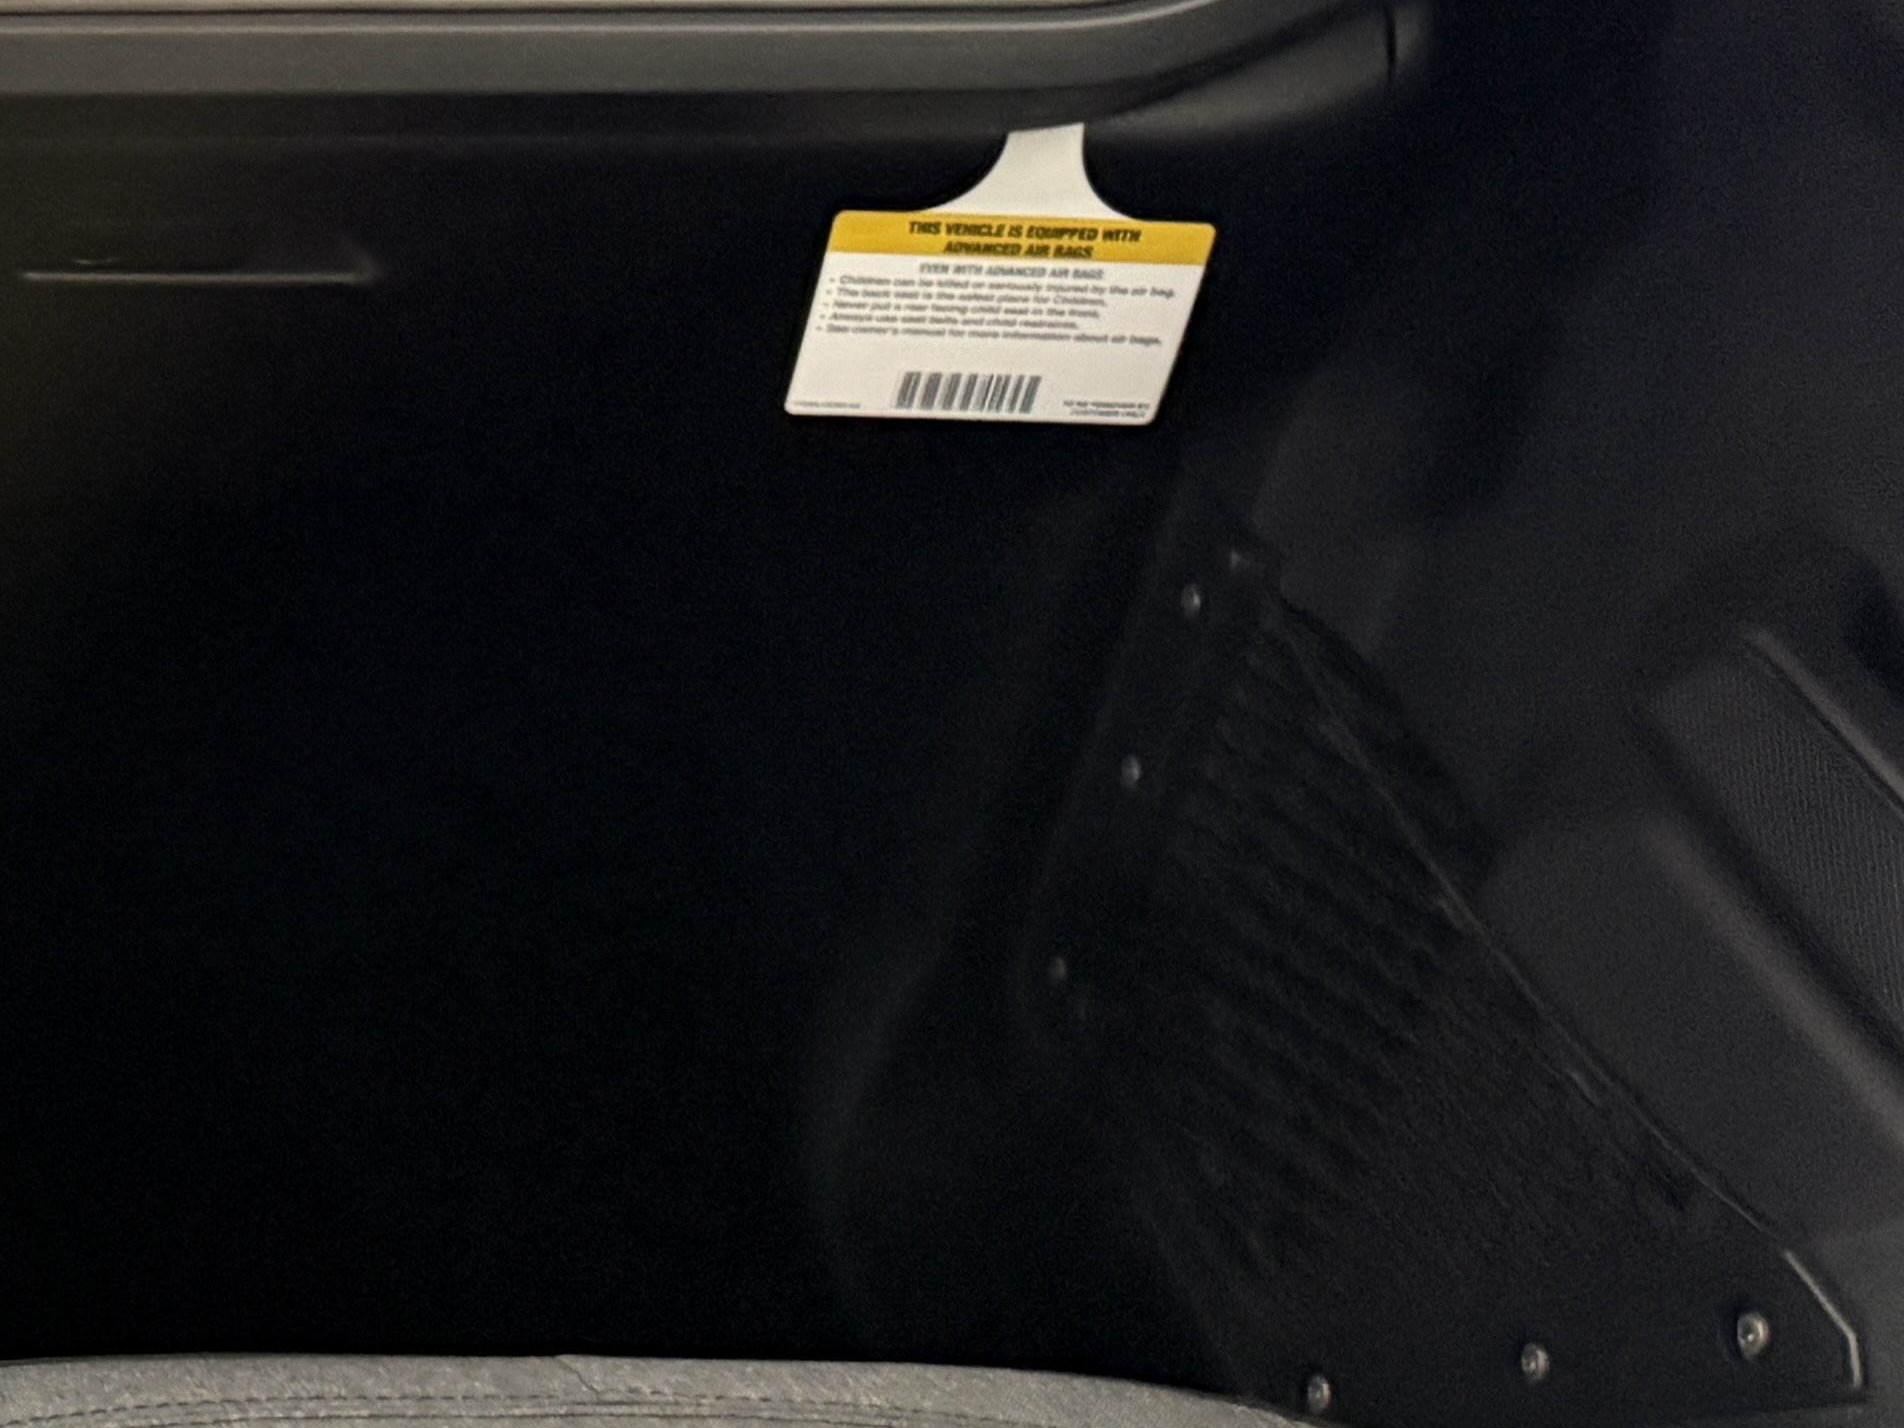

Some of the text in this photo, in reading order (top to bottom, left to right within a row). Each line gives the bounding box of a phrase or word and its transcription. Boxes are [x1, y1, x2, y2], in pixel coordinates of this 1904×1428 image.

[909, 221, 1142, 243] THIS VEHICLE IS EQUIPPED WITH
[942, 240, 1095, 259] ADVANCED AIR BAGS
[952, 263, 983, 275] WITH
[985, 264, 1046, 278] ADVANCED
[1049, 268, 1069, 279] AIR
